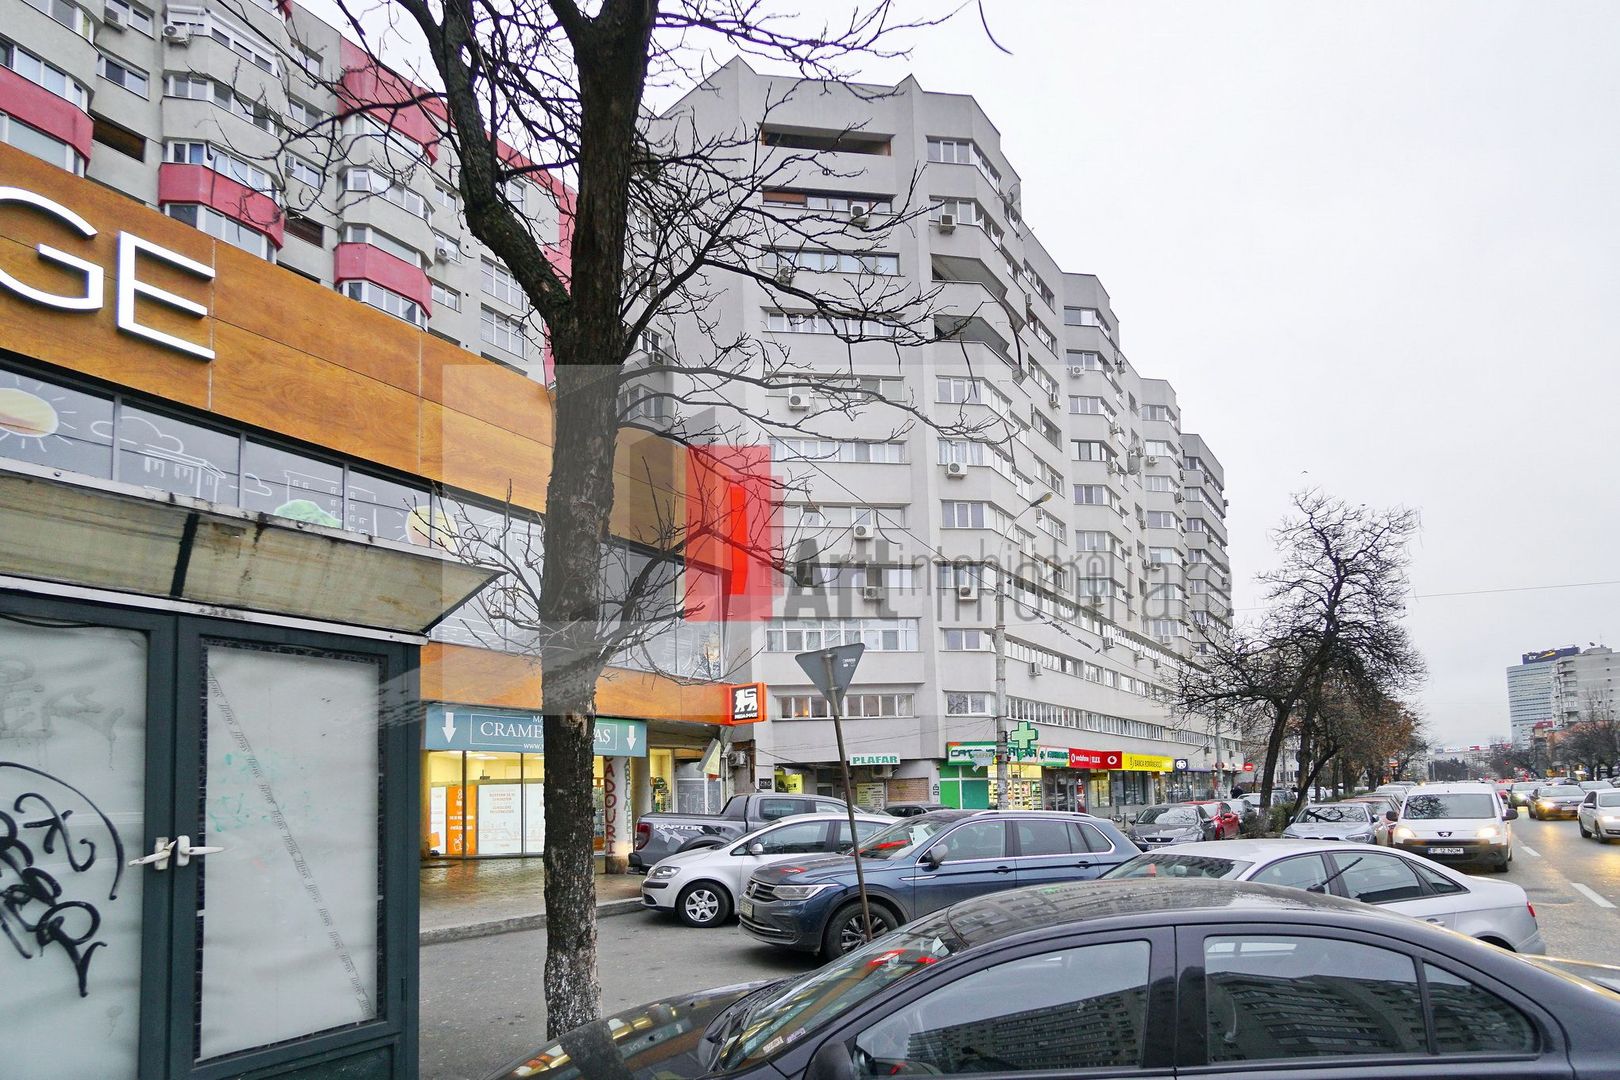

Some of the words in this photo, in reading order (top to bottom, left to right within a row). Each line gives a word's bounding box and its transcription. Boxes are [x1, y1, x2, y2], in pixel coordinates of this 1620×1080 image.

[480, 721, 544, 738] CRAME
[852, 755, 897, 764] PLAFAR
[654, 823, 705, 833] RAPTOR
